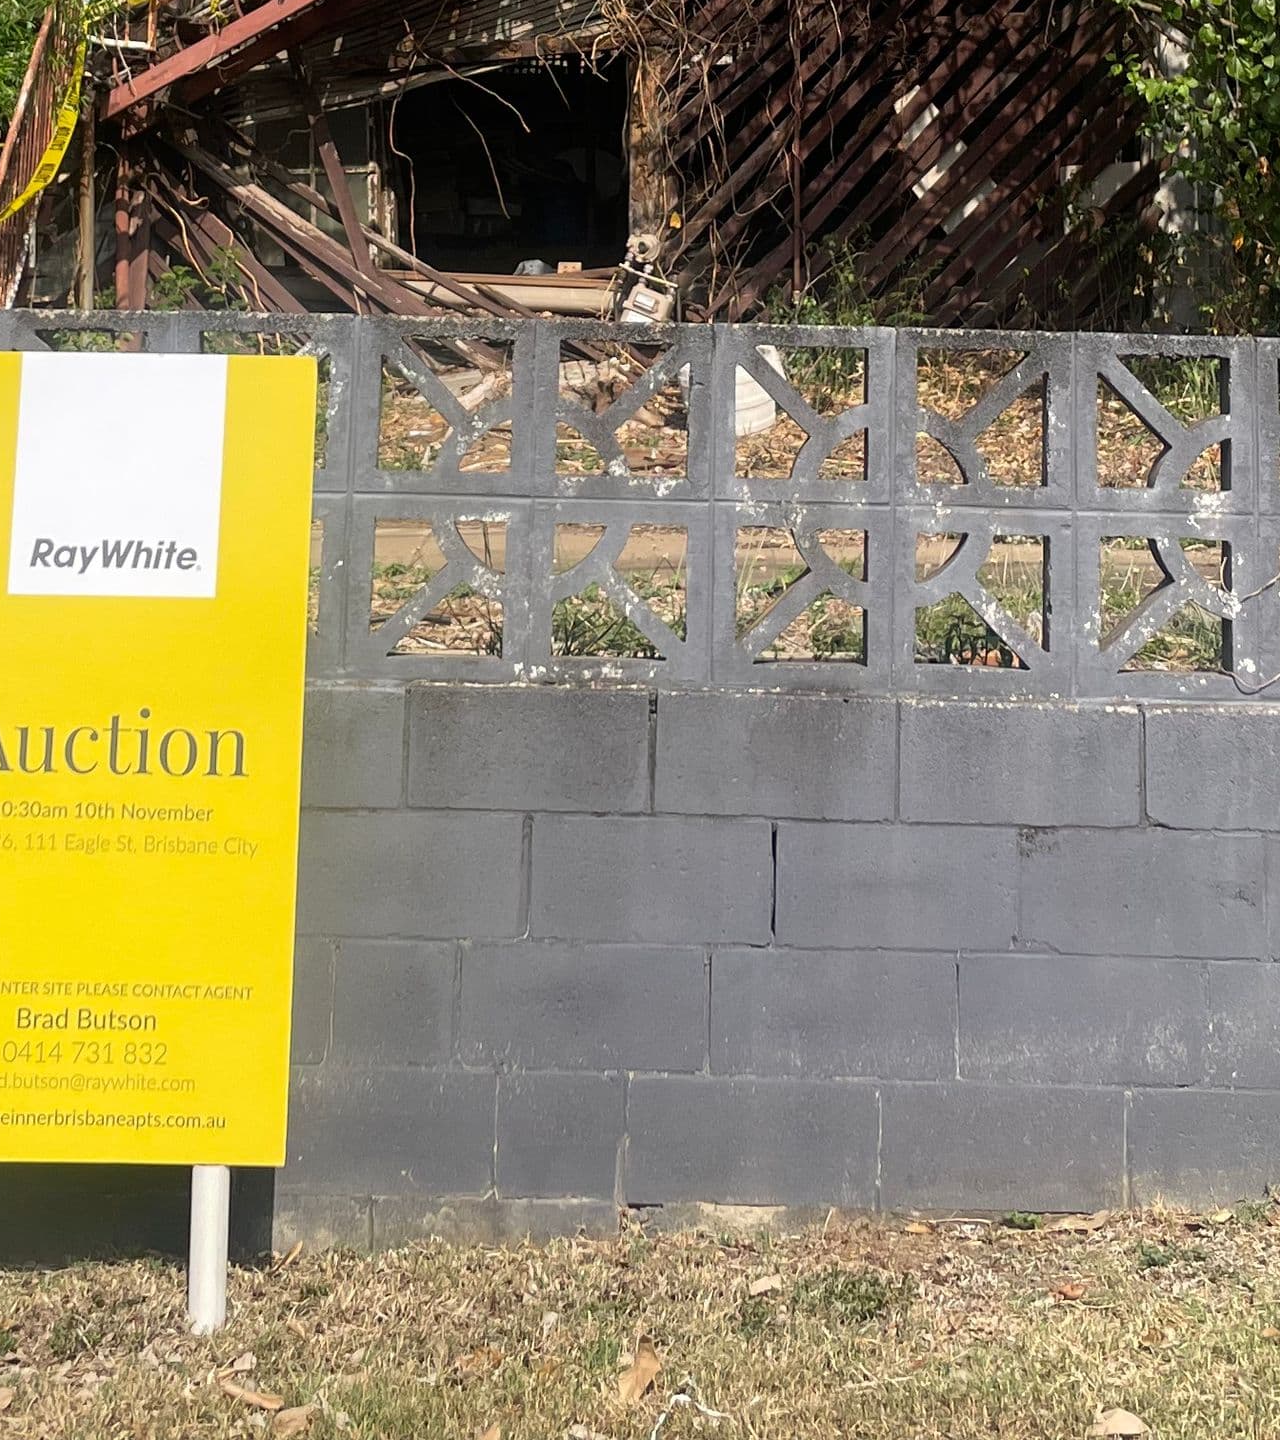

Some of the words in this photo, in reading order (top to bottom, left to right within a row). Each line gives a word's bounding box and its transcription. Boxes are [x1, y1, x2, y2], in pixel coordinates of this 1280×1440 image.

[74, 801, 115, 820] 10th
[120, 802, 214, 822] November
[24, 832, 57, 851] 111
[64, 833, 111, 855] Eagle
[143, 835, 218, 855] Brisbane
[223, 836, 259, 859] City
[43, 981, 73, 996] SITE
[76, 982, 129, 997] PLEASE
[132, 983, 203, 999] CONTACT
[204, 985, 254, 1001] AGENT
[17, 1007, 69, 1030] Brad
[77, 1008, 157, 1031] Butson
[2, 1040, 63, 1064] 0414
[71, 1041, 114, 1065] 731
[123, 1041, 168, 1065] 832
